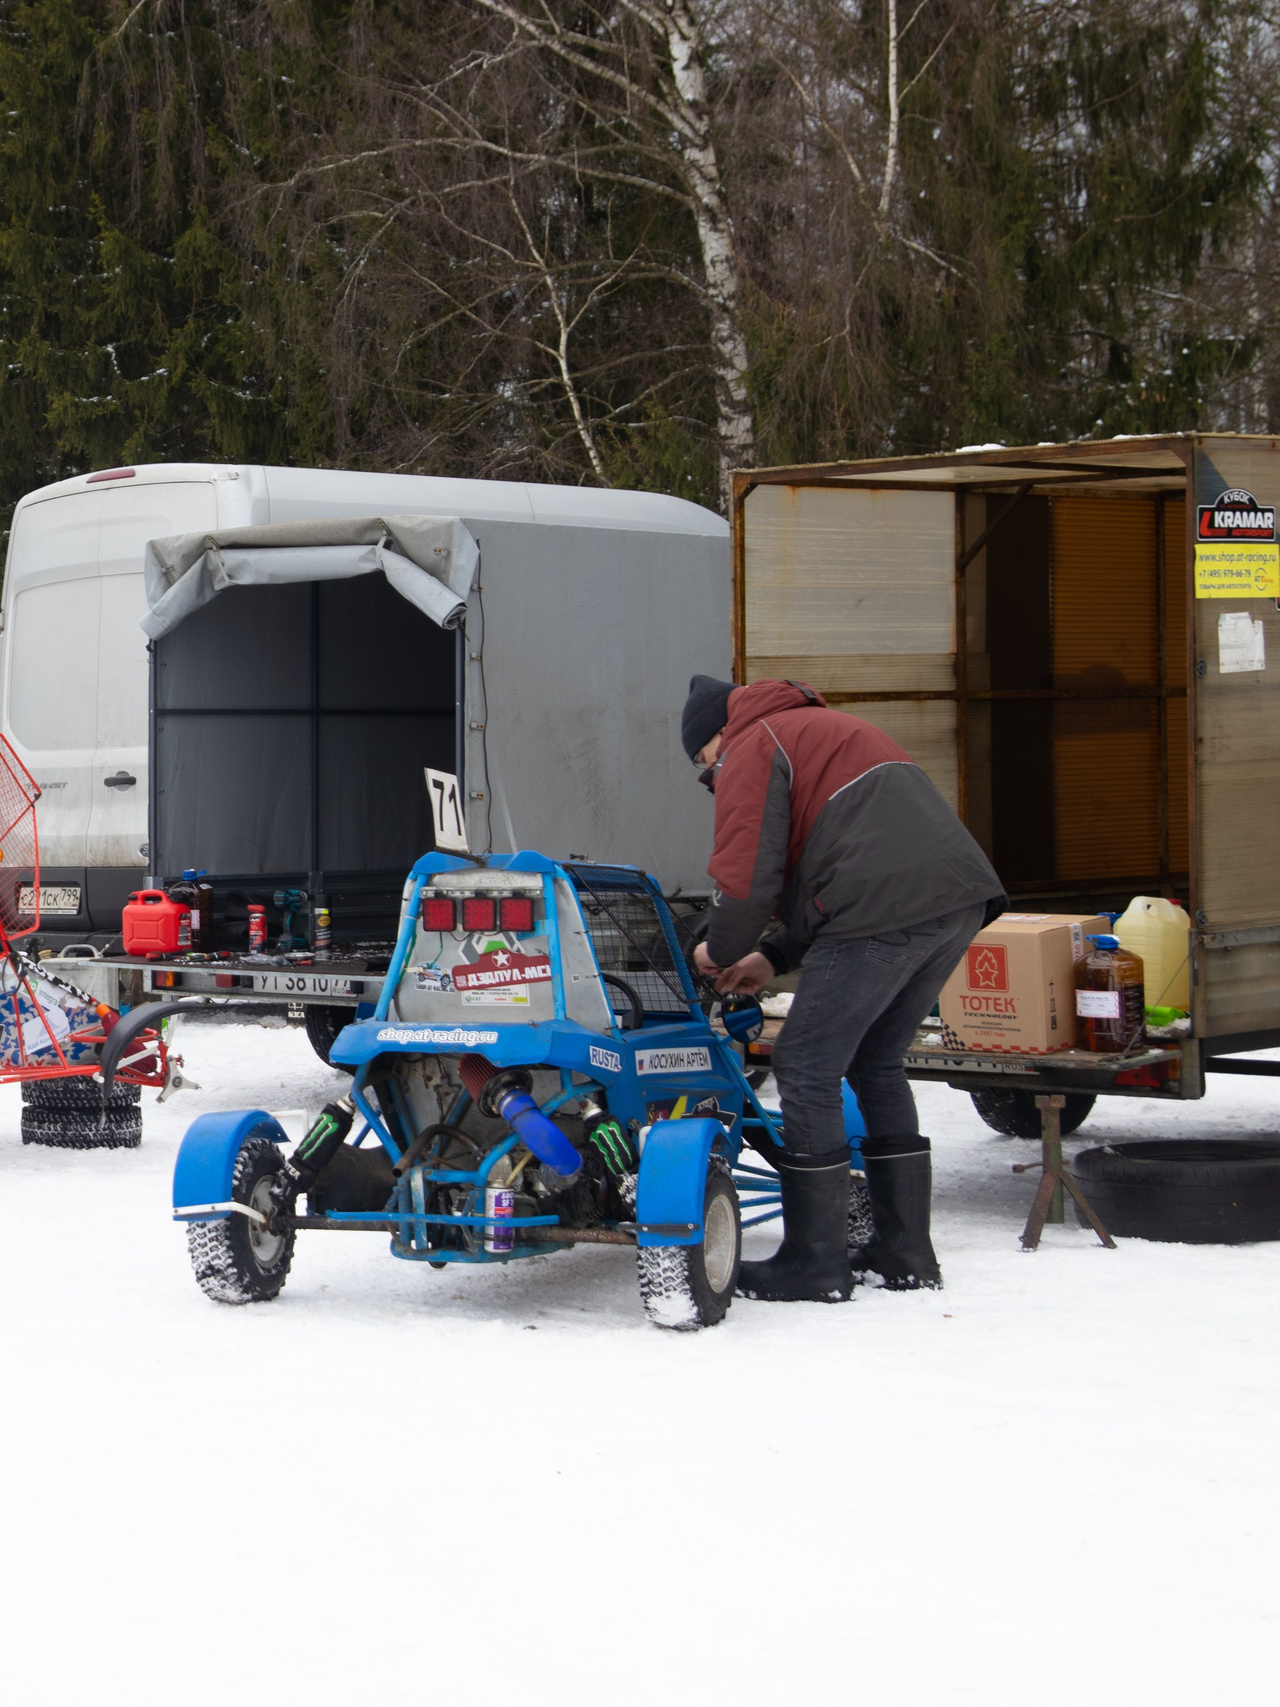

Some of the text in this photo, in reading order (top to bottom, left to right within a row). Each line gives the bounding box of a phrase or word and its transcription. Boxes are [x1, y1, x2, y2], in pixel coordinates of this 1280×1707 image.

[1224, 492, 1250, 505] КУБОК
[1214, 511, 1274, 528] KRAMAR
[1199, 551, 1276, 565] www.shop.at-racing.ru
[432, 778, 462, 836] 71
[959, 995, 1017, 1014] TOTEK
[963, 1012, 1018, 1020] TECHNOLOGY
[378, 1028, 497, 1045] shop.at-racing.ru
[591, 1048, 620, 1070] RUSTA
[648, 1048, 709, 1070] КОСУХИН АРТЁМ
